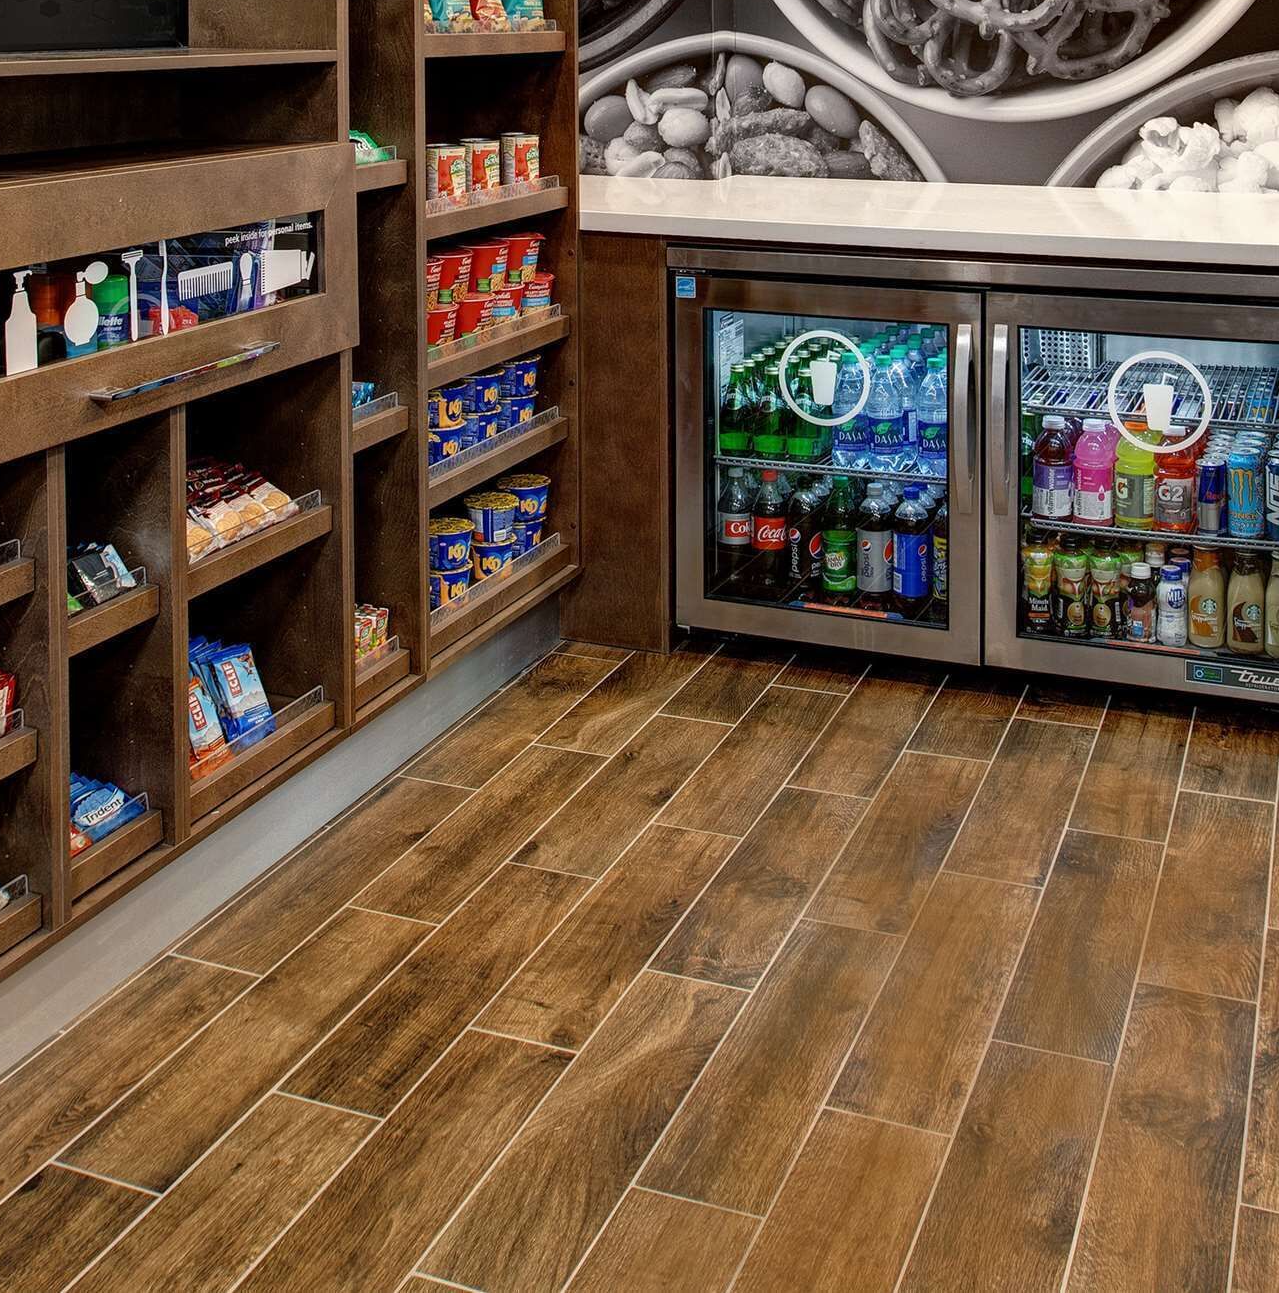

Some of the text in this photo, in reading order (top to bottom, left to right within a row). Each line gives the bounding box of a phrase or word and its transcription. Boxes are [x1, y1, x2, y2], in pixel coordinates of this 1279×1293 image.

[923, 438, 946, 449] DASA
[1158, 482, 1184, 502] G2
[791, 544, 799, 573] pepsi
[83, 797, 123, 824] Trident
